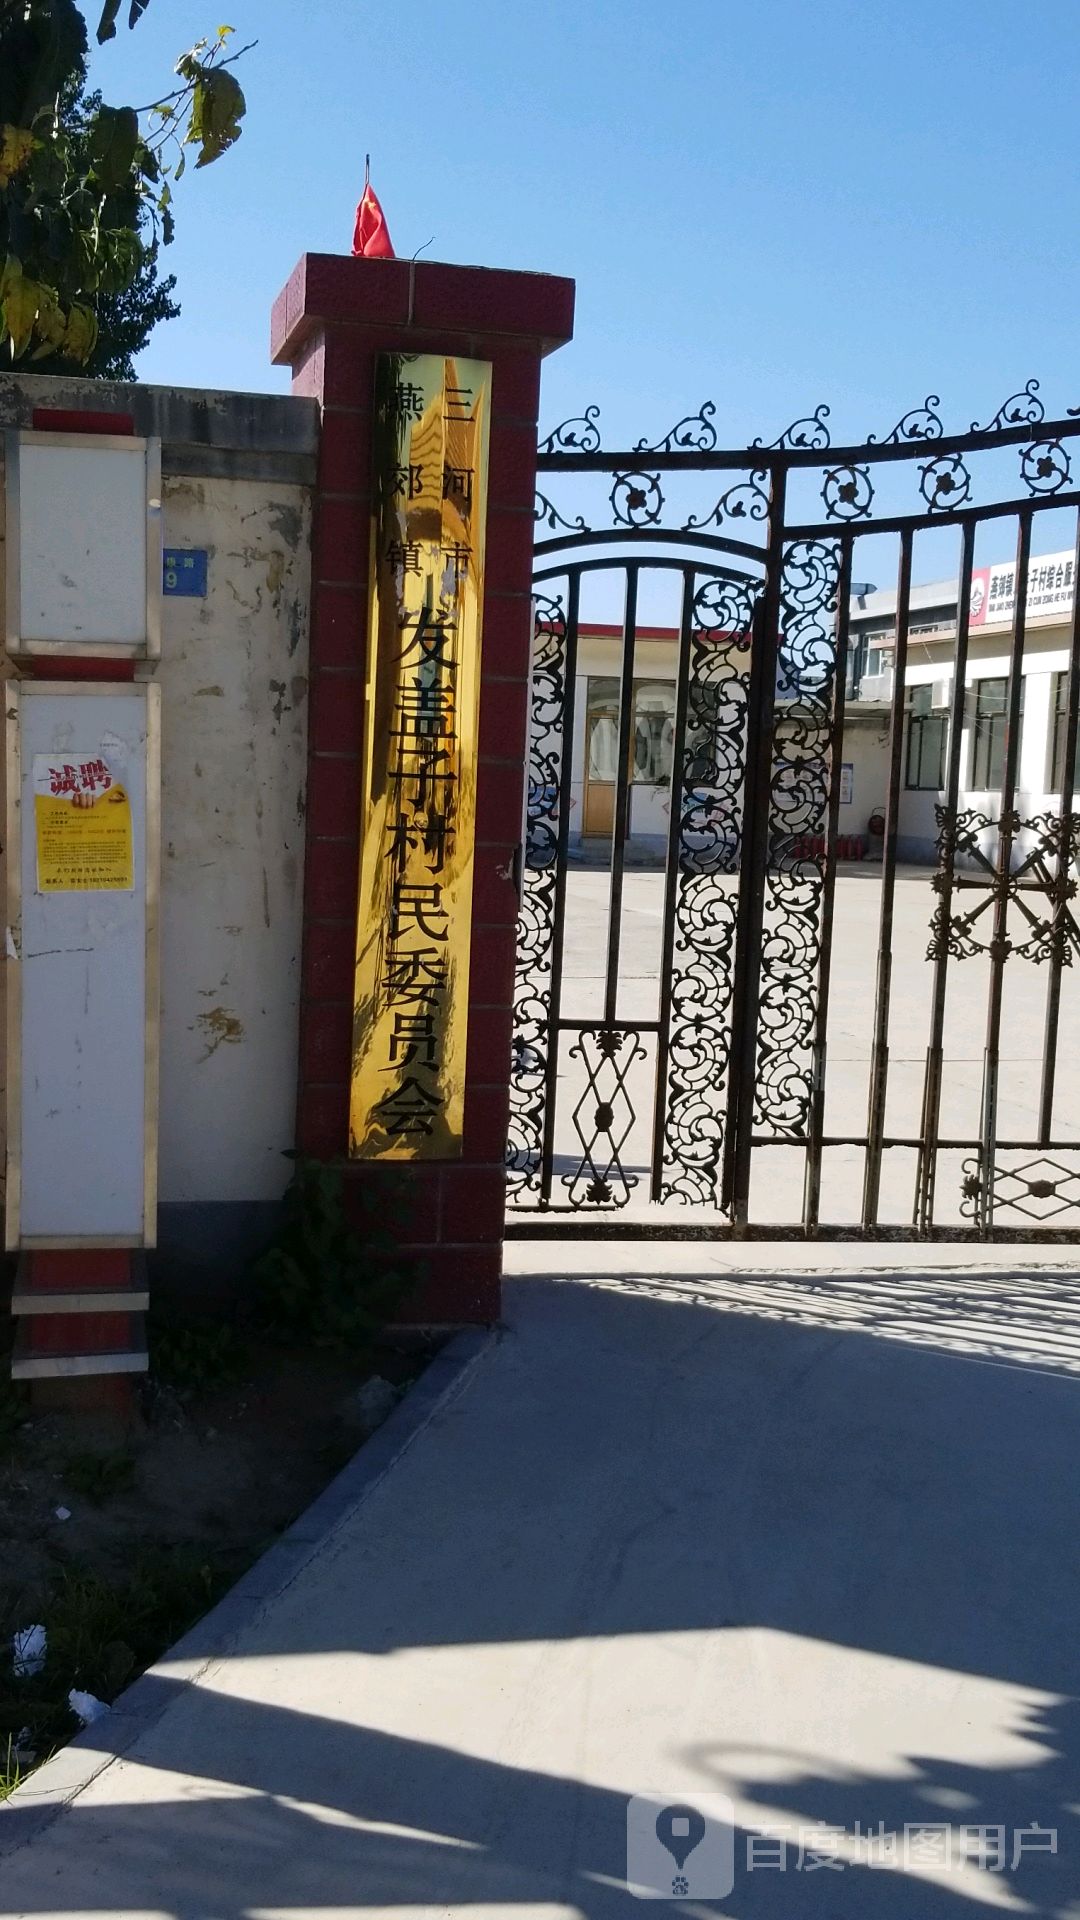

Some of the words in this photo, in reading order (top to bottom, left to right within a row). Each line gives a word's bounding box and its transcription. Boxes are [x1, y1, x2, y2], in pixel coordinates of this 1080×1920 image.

[385, 382, 424, 577] 燕郊镇
[442, 387, 475, 578] 三河市
[166, 572, 177, 588] 9
[990, 562, 1075, 599] 燕郊镇子村综合服
[48, 759, 113, 796] 诚聘
[378, 607, 460, 1137] 发盖子村民委员会
